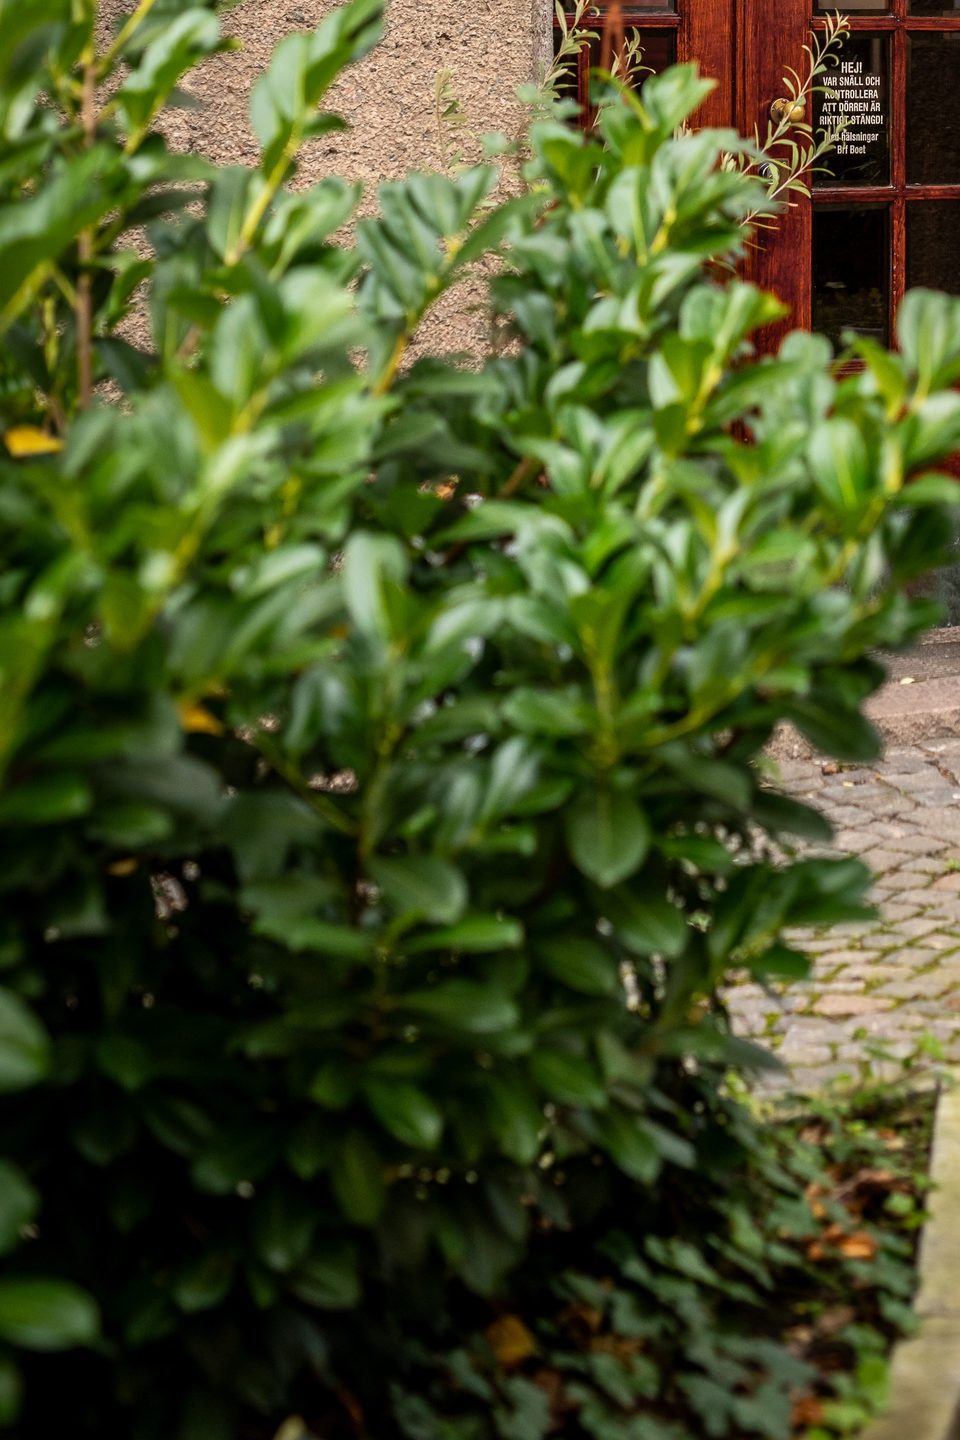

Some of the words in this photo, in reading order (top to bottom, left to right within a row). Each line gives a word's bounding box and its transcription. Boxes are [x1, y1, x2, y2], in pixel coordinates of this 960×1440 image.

[841, 61, 862, 73] HEJ!
[823, 76, 838, 86] VAR
[839, 74, 864, 86] SNÄLL
[865, 76, 880, 86] OCH
[822, 102, 837, 112] ATT
[839, 100, 869, 112] DÖRREN
[870, 100, 881, 112] ÄR
[850, 113, 883, 125] STÄNGD!
[841, 131, 879, 143] hälsningar
[849, 144, 866, 155] Boet
